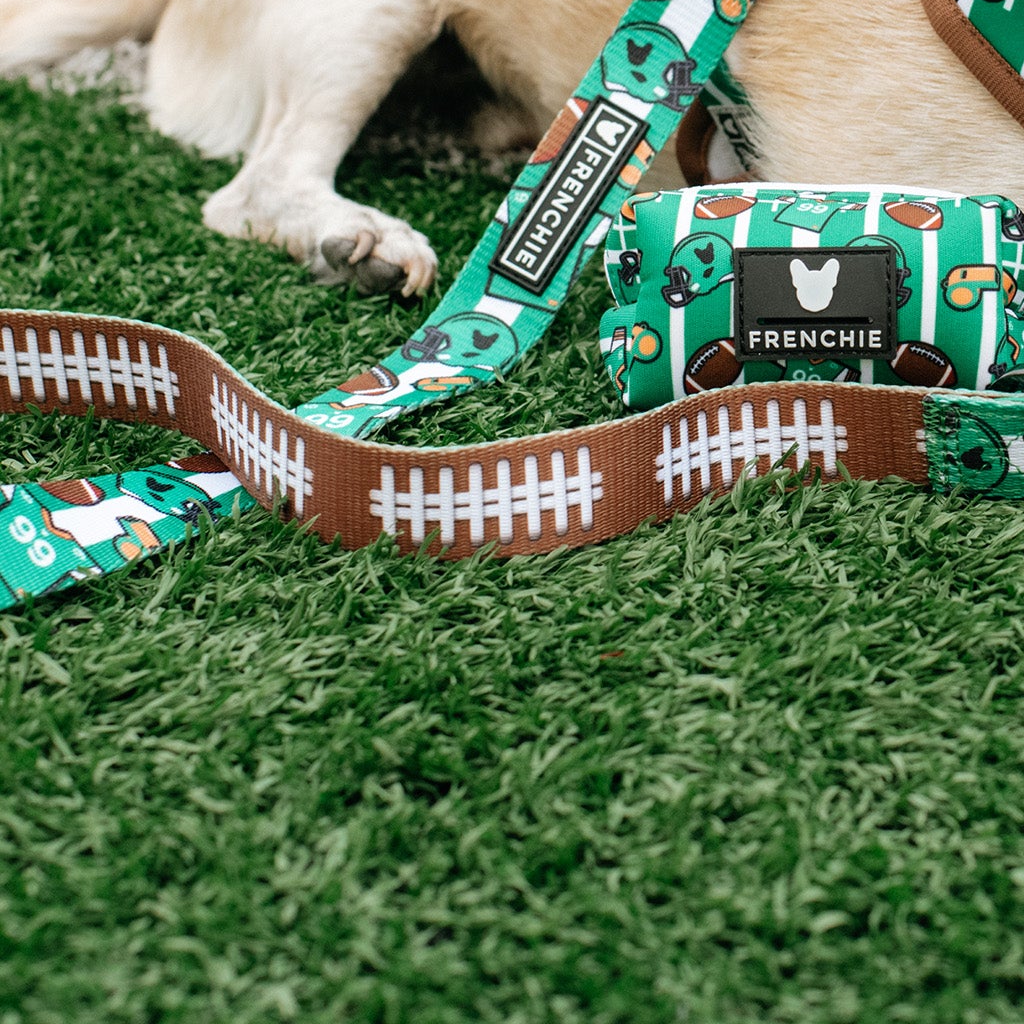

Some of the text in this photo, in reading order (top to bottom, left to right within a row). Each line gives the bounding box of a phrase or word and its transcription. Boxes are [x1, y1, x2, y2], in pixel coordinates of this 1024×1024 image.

[515, 147, 602, 268] FRENCHIE
[797, 202, 829, 214] 99
[749, 329, 883, 349] FRENCHIE
[8, 514, 57, 568] 99
